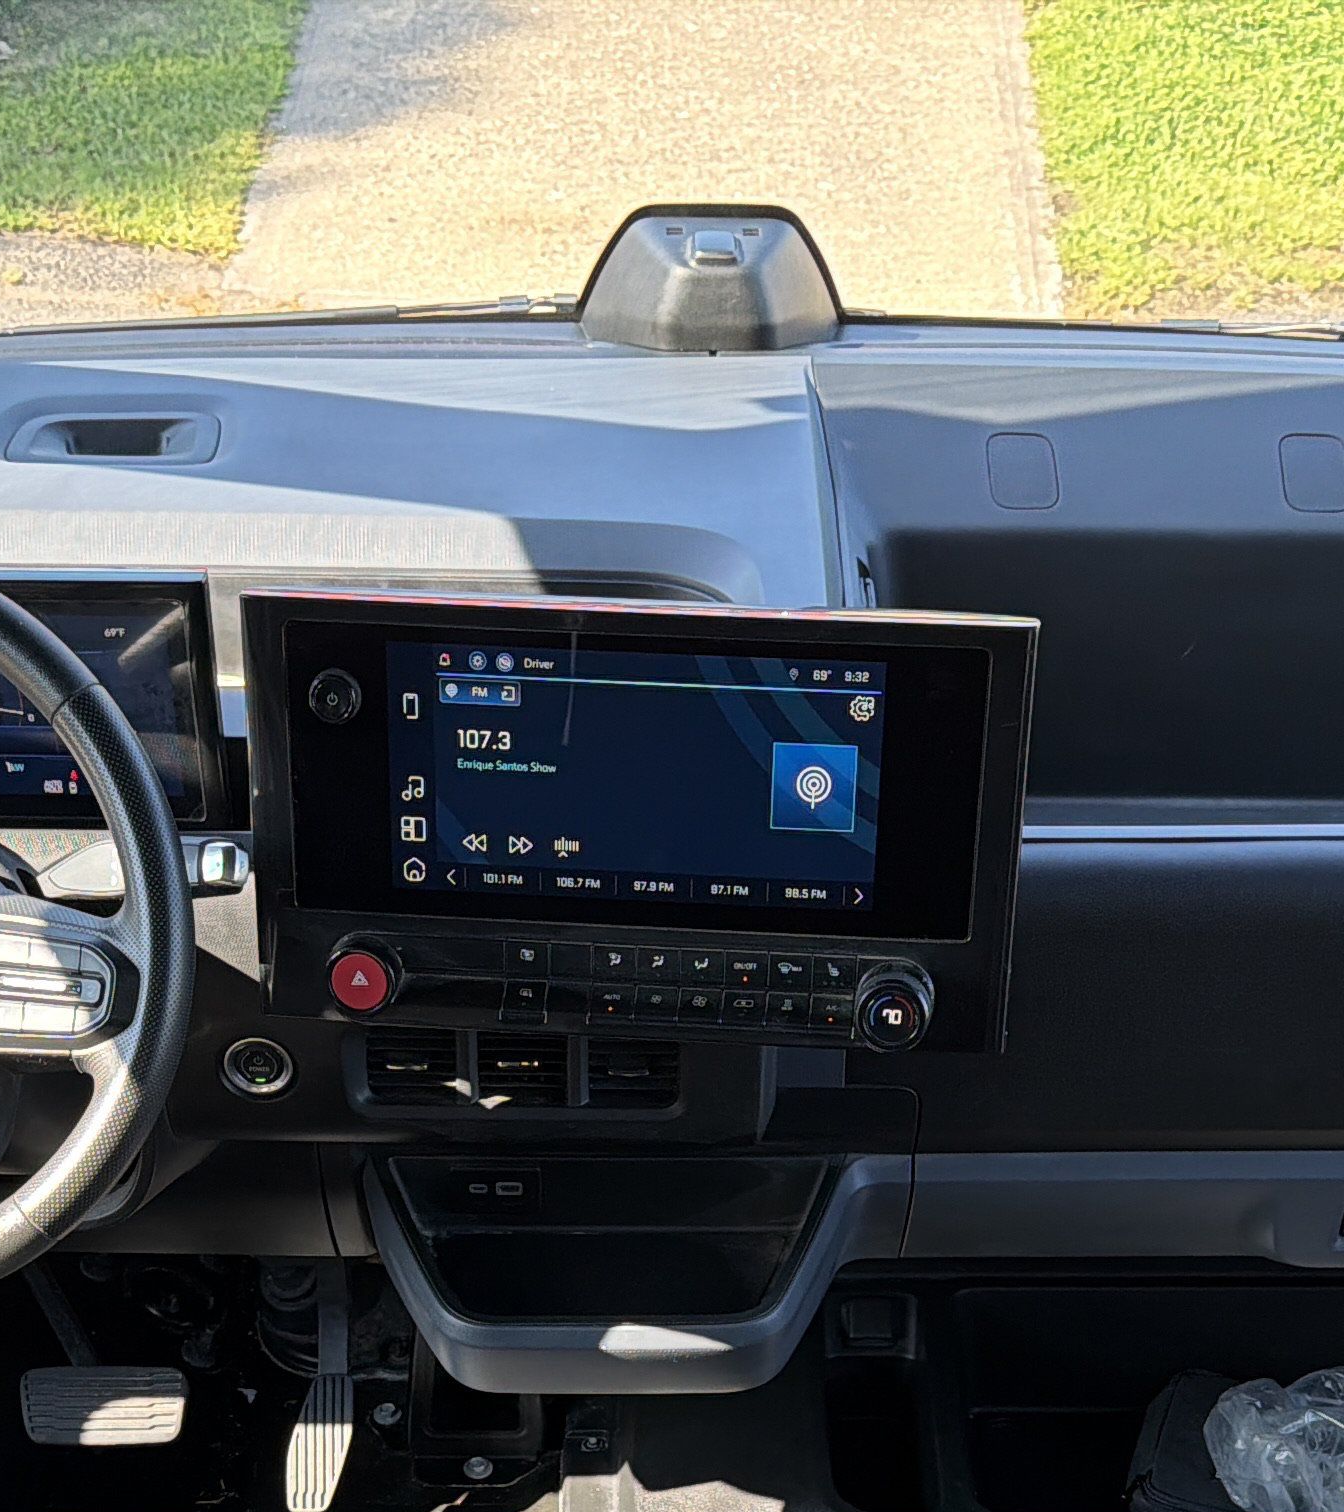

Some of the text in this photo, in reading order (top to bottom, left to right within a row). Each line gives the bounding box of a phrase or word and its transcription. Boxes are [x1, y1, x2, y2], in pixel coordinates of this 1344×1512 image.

[104, 627, 126, 638] 69°F
[524, 658, 555, 669] Driver
[813, 670, 870, 683] 69° 9:32
[471, 687, 488, 698] FM
[456, 729, 511, 750] 107.3
[457, 758, 557, 773] Enrique Santos Show
[483, 873, 523, 885] 101.1 FM
[556, 877, 601, 889] 106.7 FM
[633, 880, 674, 893] 97.9 FM
[710, 884, 749, 896] 97.1 FM
[785, 887, 827, 900] 98.5 FM
[734, 962, 757, 971] ON/OFF
[604, 993, 621, 1001] AUTO
[882, 1008, 902, 1025] 70
